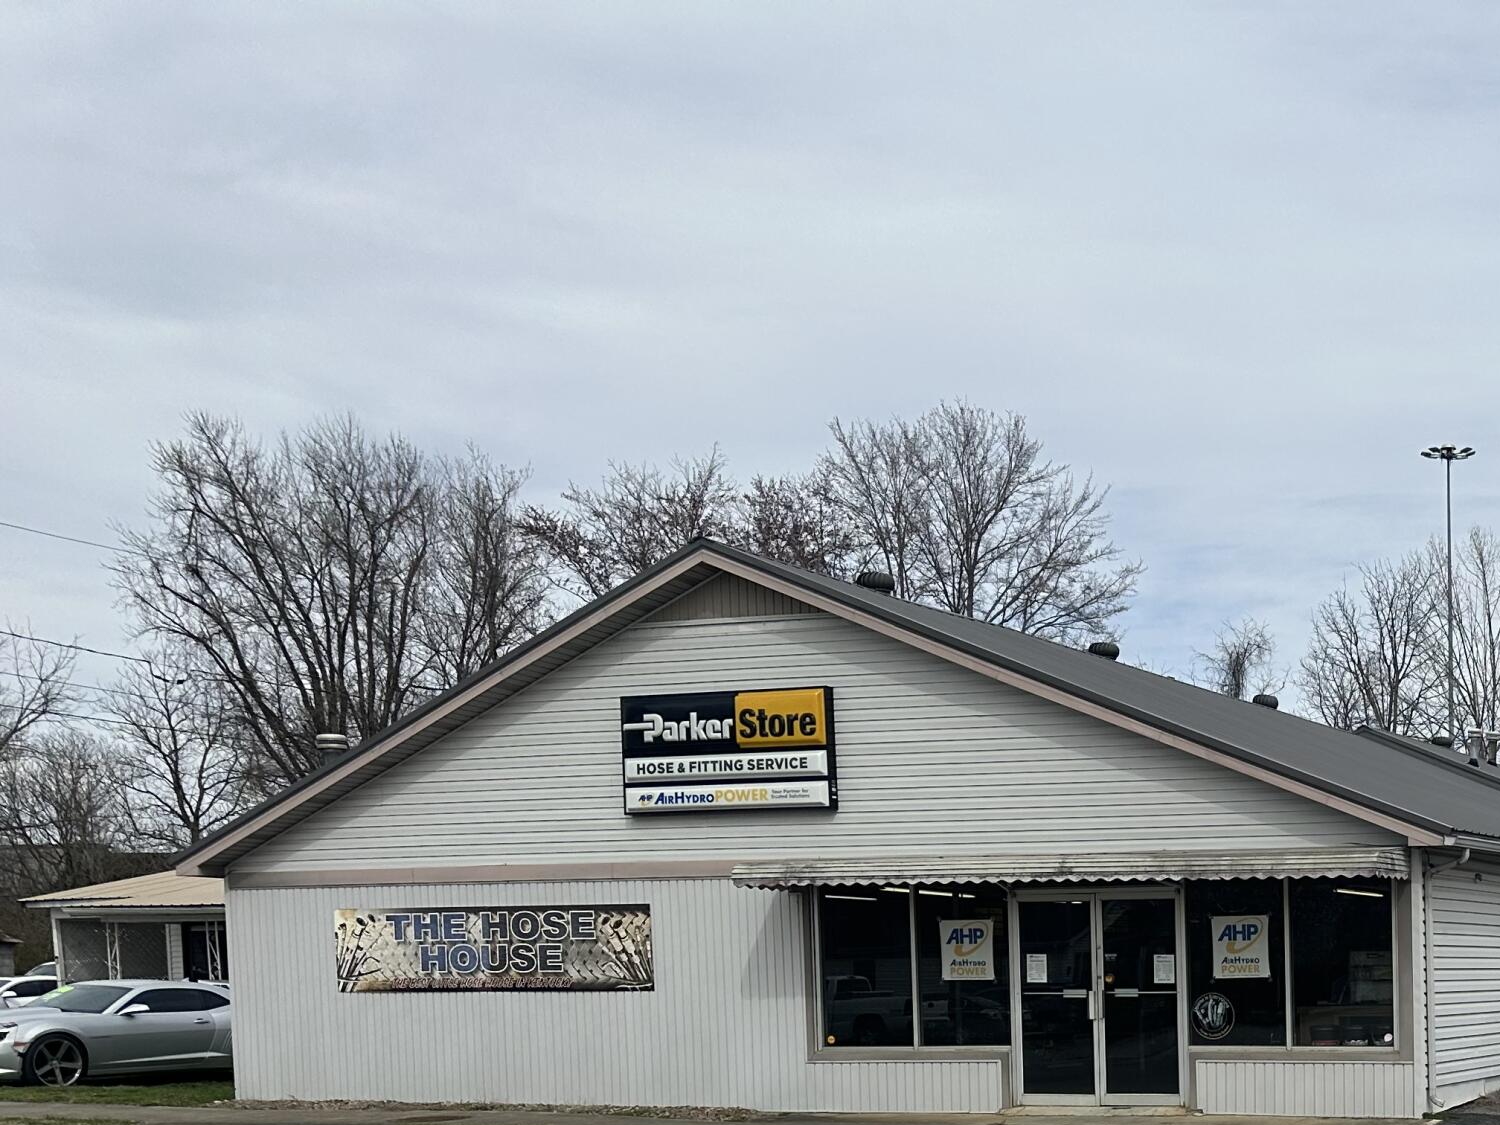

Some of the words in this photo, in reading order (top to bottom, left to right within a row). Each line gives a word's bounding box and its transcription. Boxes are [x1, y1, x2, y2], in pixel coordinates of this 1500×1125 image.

[623, 711, 734, 743] Parker
[738, 708, 817, 738] Store
[636, 761, 674, 775] HOSE
[677, 761, 686, 773] &
[689, 759, 744, 773] FITTING
[747, 757, 808, 771] SERVICE
[385, 912, 469, 942] THE
[479, 910, 597, 942] HOSE
[1218, 923, 1259, 942] AHP
[945, 927, 985, 945] AHP
[420, 943, 564, 973] HOUSE
[950, 966, 987, 976] POWER
[1221, 964, 1260, 974] POWER
